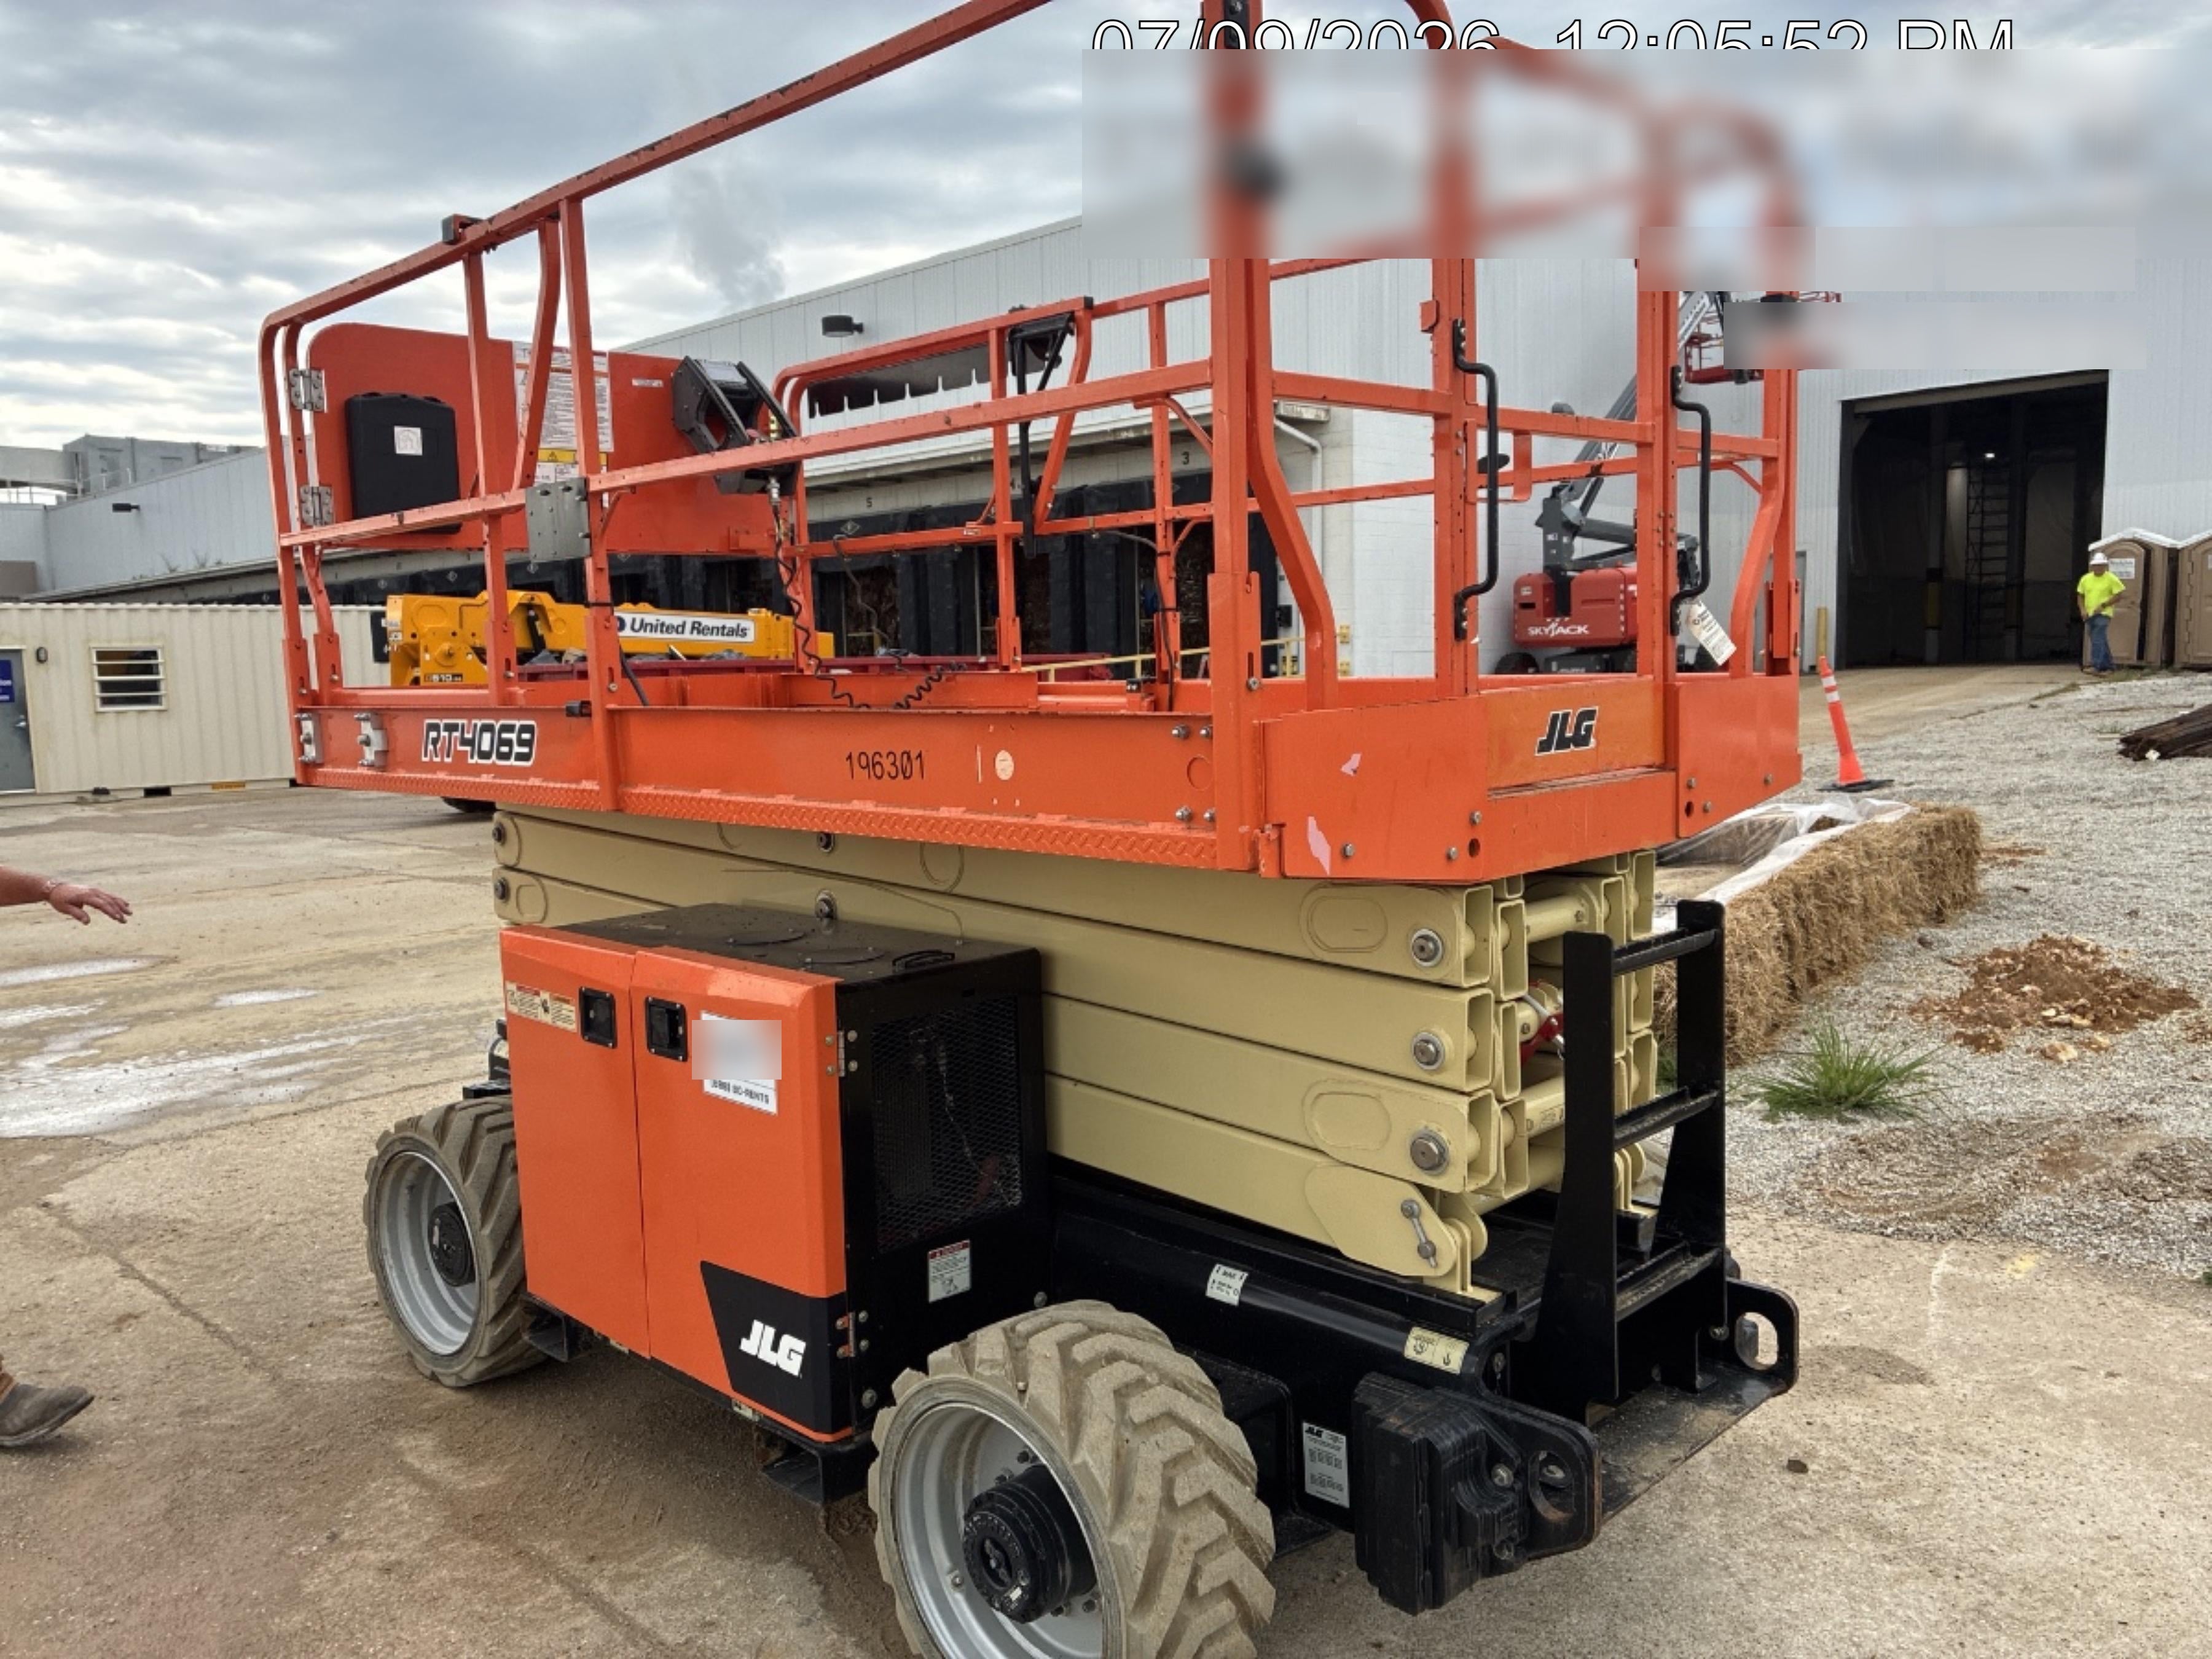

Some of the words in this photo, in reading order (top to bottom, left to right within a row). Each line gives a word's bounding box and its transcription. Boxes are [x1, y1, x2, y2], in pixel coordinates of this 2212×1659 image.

[1180, 451, 1190, 465] 3
[630, 617, 686, 635] United
[689, 621, 749, 638] Rentals
[1528, 622, 1590, 637] SKYJACK
[422, 719, 537, 766] RT4069
[1534, 706, 1599, 756] JLG
[845, 750, 925, 780] 196301
[740, 1319, 806, 1376] JLG
